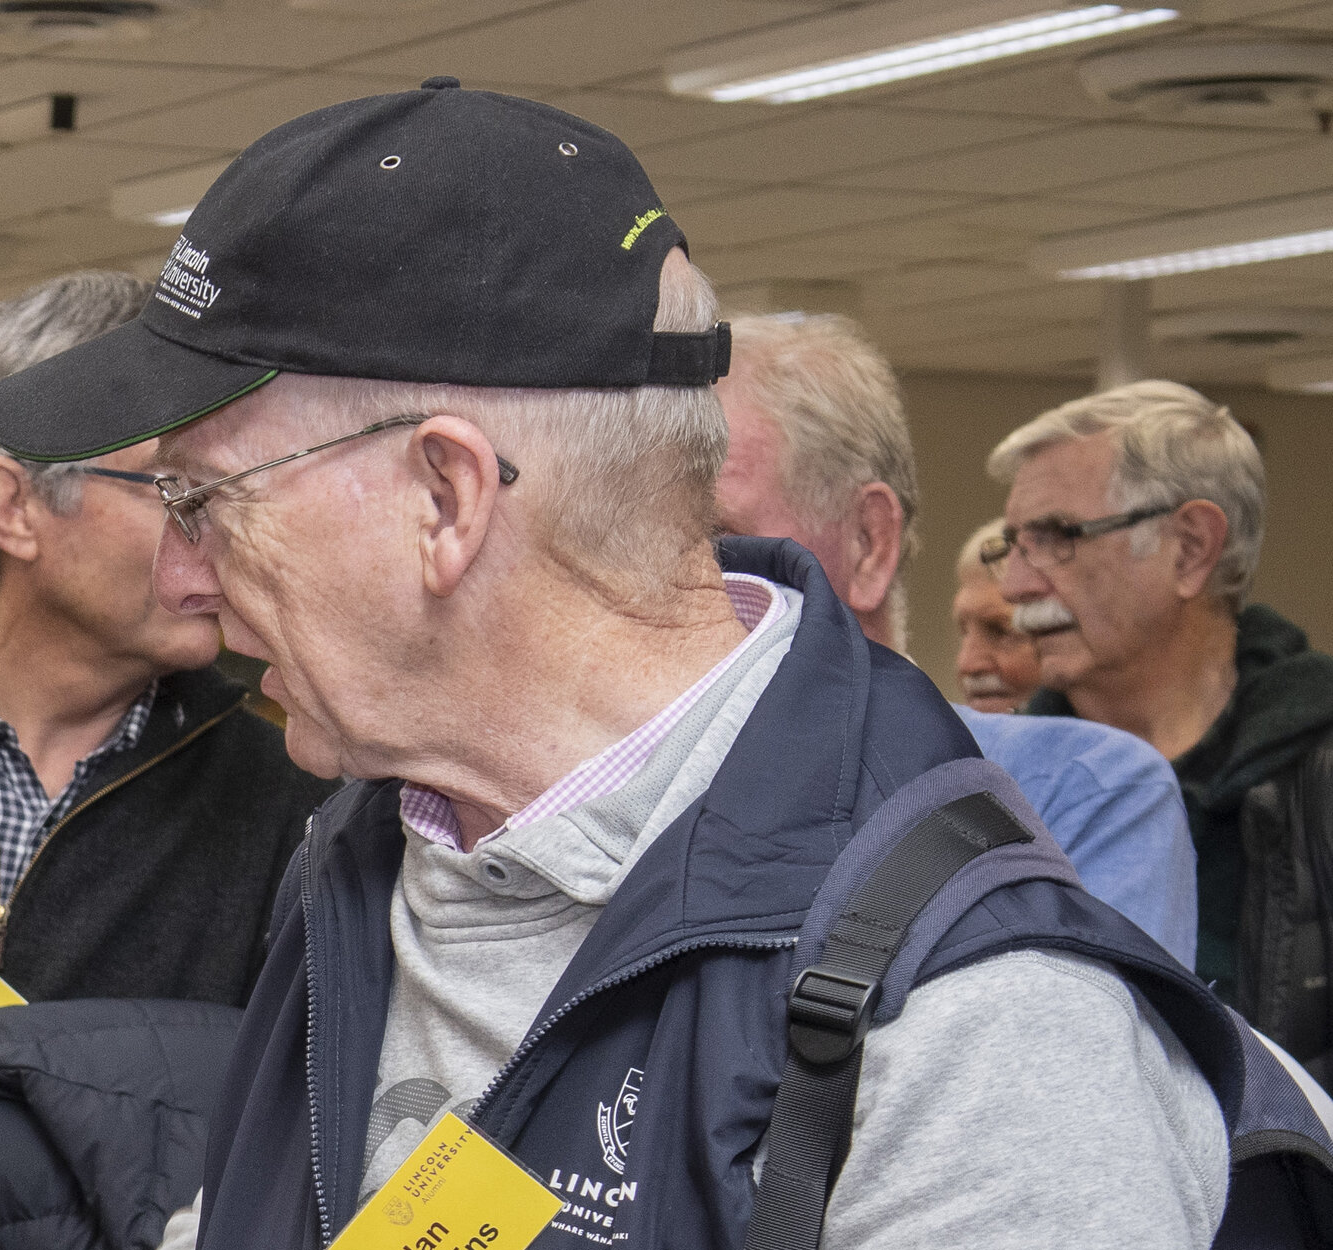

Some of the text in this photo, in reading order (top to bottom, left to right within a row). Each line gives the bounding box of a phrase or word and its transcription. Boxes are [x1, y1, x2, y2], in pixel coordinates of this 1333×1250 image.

[175, 240, 210, 275] Lincoln
[163, 259, 222, 309] University
[403, 1141, 448, 1191] LINCOLN
[411, 1128, 474, 1198] UNIVERSITY
[421, 1177, 446, 1205] Alumni
[549, 1168, 638, 1207] LINCN
[551, 1221, 583, 1236] WHARE
[586, 1231, 613, 1246] WĀNA
